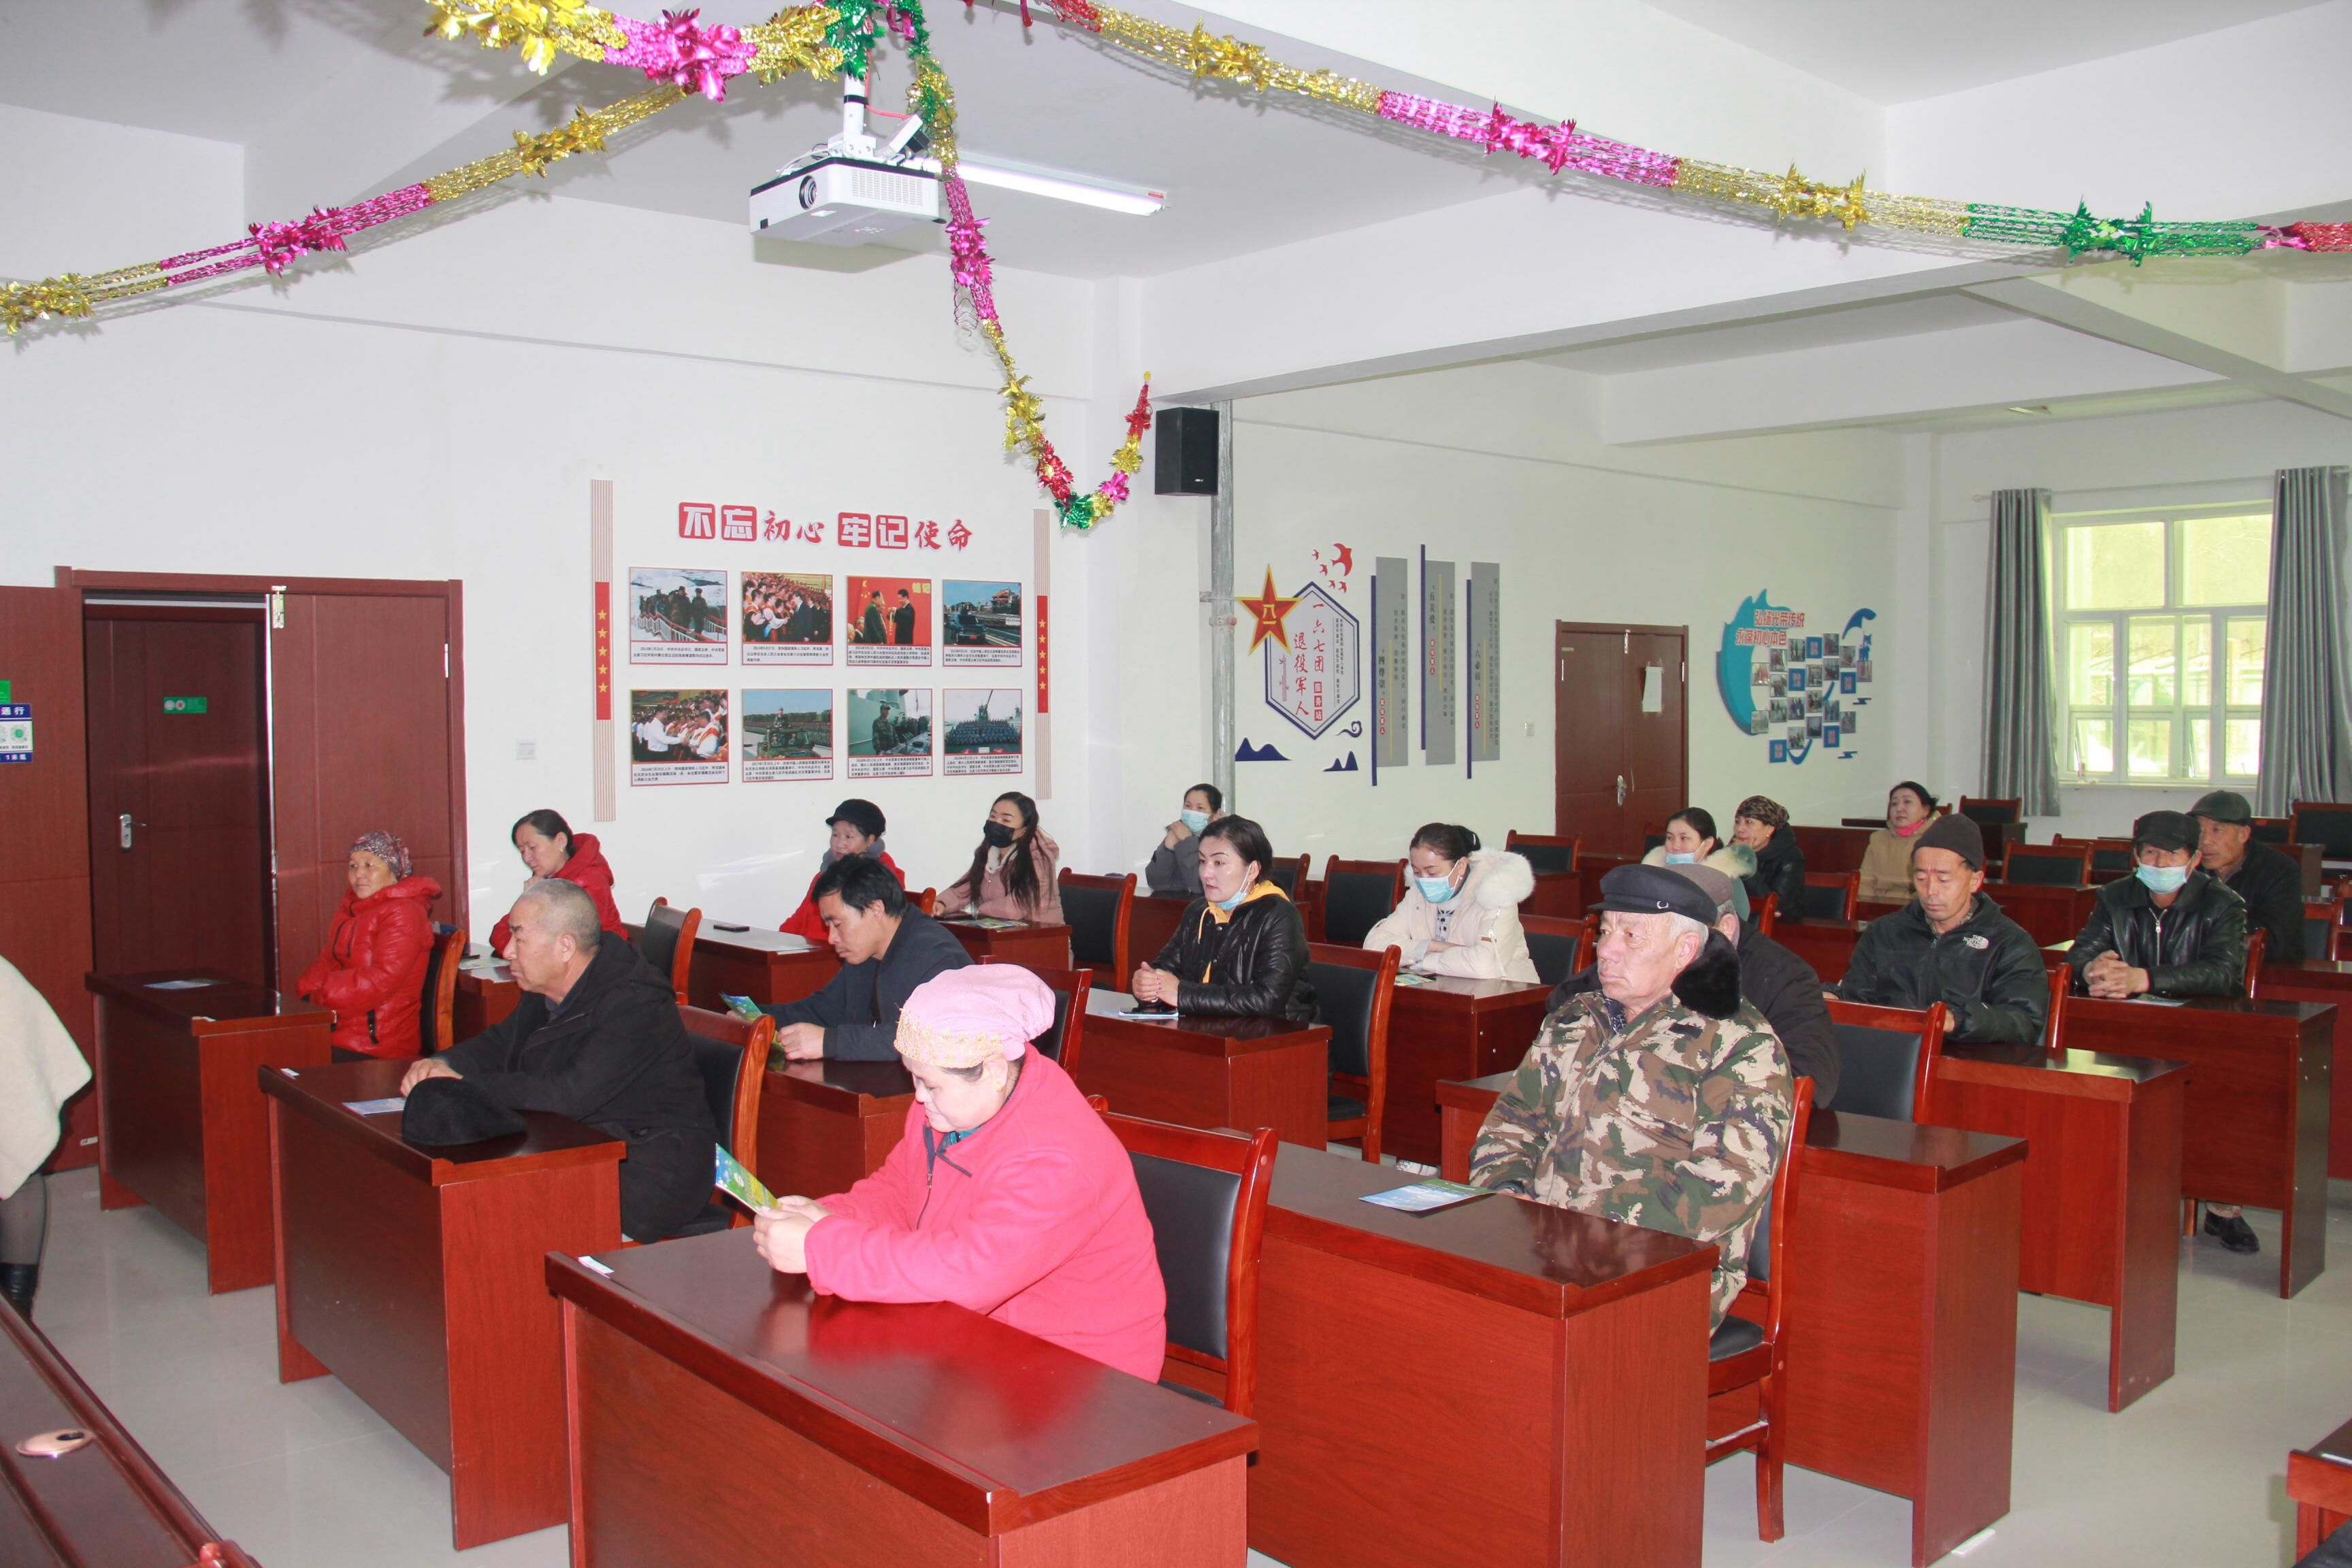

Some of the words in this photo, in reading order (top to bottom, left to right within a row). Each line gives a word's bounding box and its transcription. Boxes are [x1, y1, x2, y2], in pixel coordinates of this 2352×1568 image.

[679, 501, 826, 544] 不忘初心
[838, 512, 973, 552] 牢记使命
[1262, 604, 1277, 625] 八一
[1754, 609, 1806, 628] 弘扬光荣传统
[1312, 603, 1325, 673] 一六七团
[1736, 628, 1787, 645] 永葆初心本色
[1294, 632, 1309, 716] 退役军人
[1, 706, 25, 715] 通行
